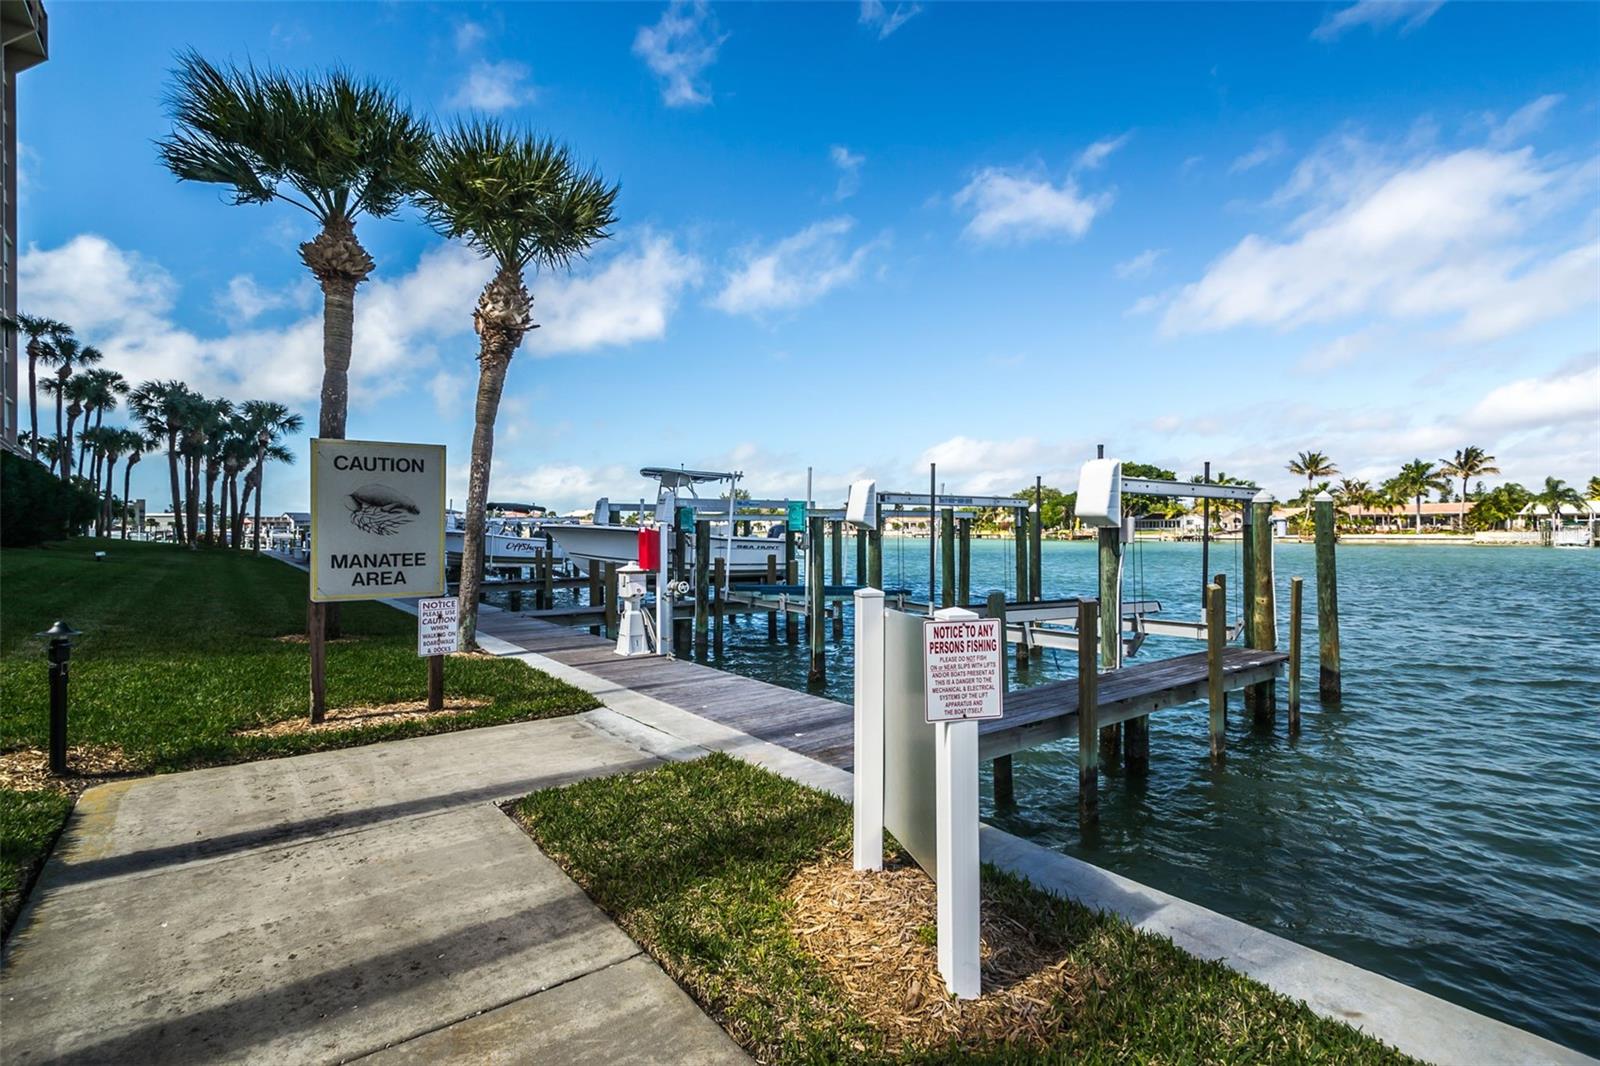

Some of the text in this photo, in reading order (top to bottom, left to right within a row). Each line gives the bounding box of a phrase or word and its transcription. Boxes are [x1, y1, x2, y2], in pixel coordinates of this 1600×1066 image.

[334, 455, 425, 473] CAUTION
[506, 542, 545, 552] OffSho
[331, 552, 426, 569] MANATEE
[352, 572, 407, 586] AREA
[422, 600, 456, 609] NOTICE
[422, 617, 456, 625] CAUTION
[934, 624, 994, 639] NOTICE TO ANY
[929, 639, 996, 654] PERSONS FISHING
